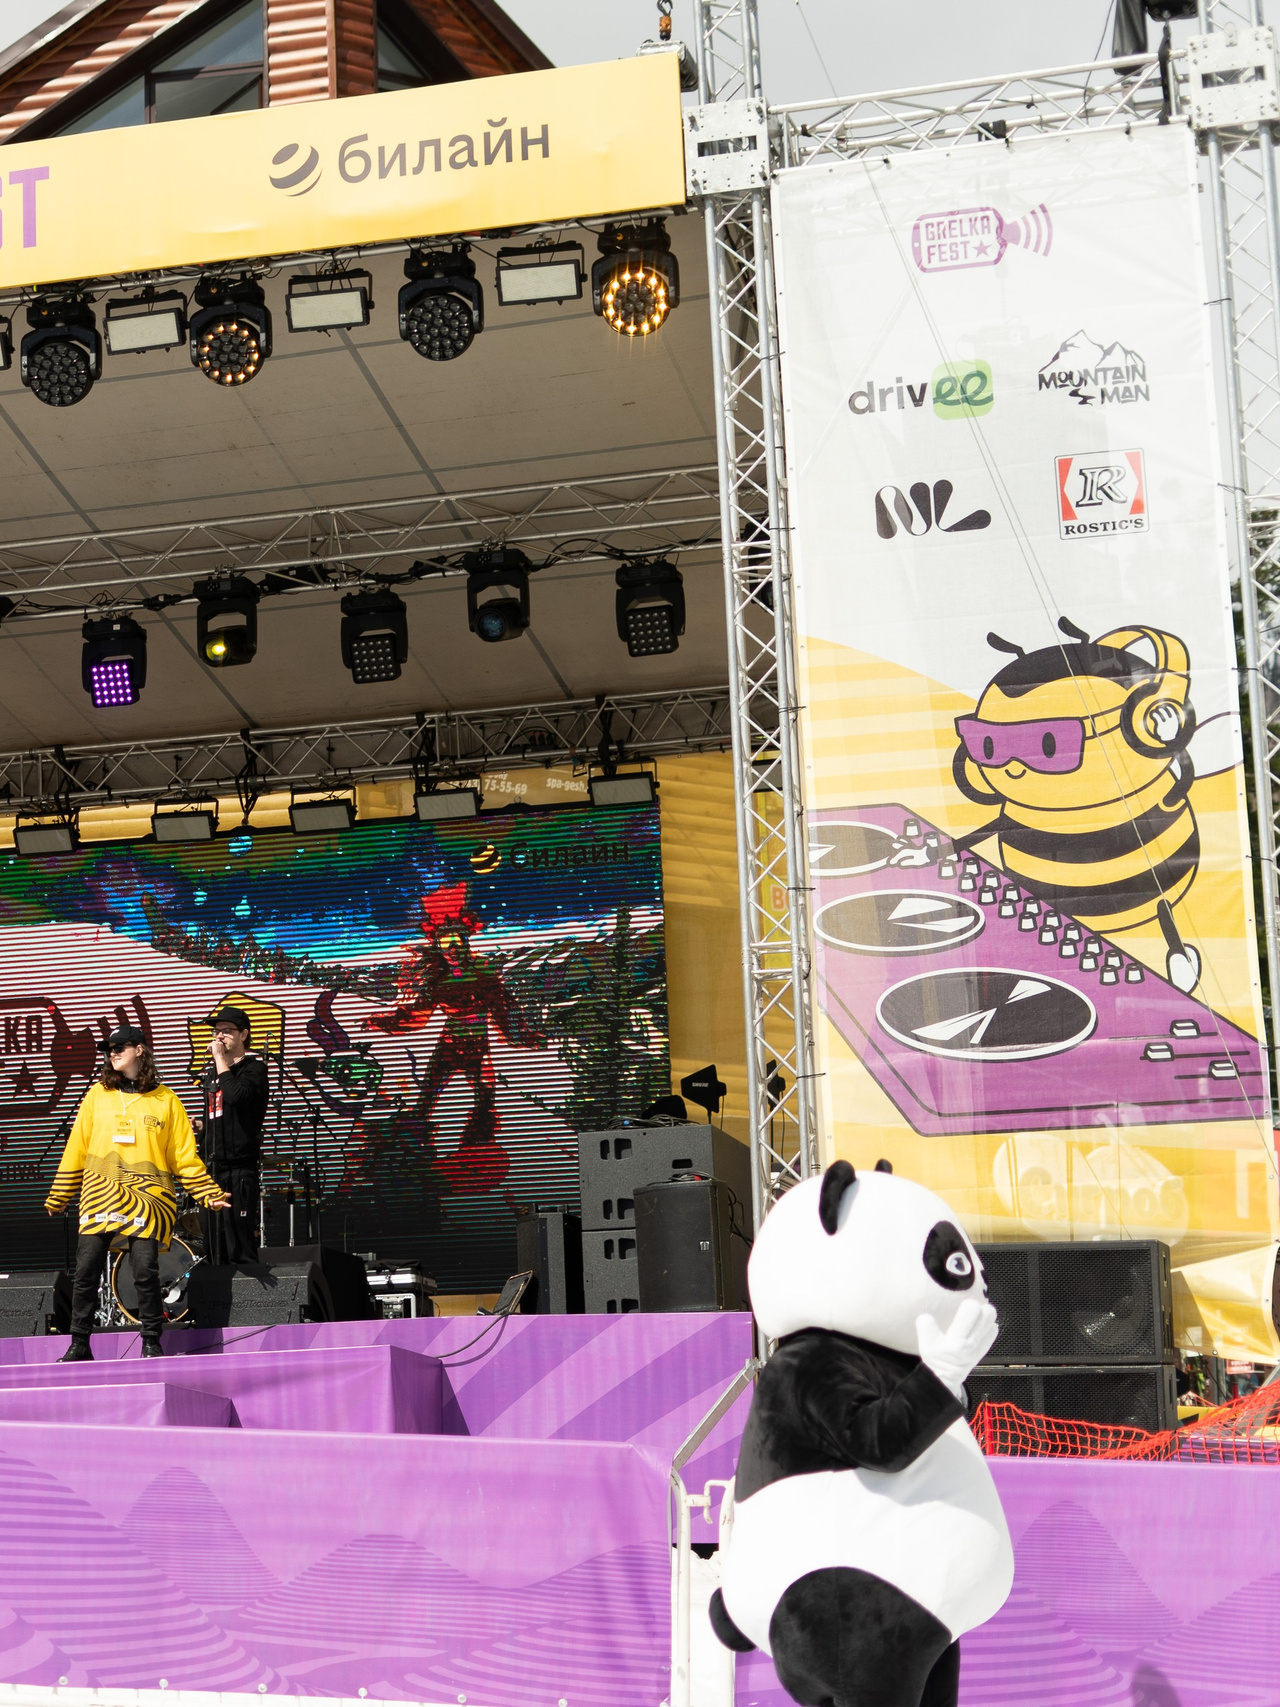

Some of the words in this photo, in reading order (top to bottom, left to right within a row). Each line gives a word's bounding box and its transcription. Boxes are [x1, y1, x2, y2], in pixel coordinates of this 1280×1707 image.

[337, 117, 550, 184] билайн
[925, 215, 991, 241] GRELKA
[926, 240, 970, 264] FEST
[1038, 364, 1148, 391] MOUNTAIN
[848, 370, 995, 415] drivee
[1100, 384, 1151, 405] MAN
[1064, 518, 1145, 535] ROSTIC'S
[510, 836, 630, 869] билайн
